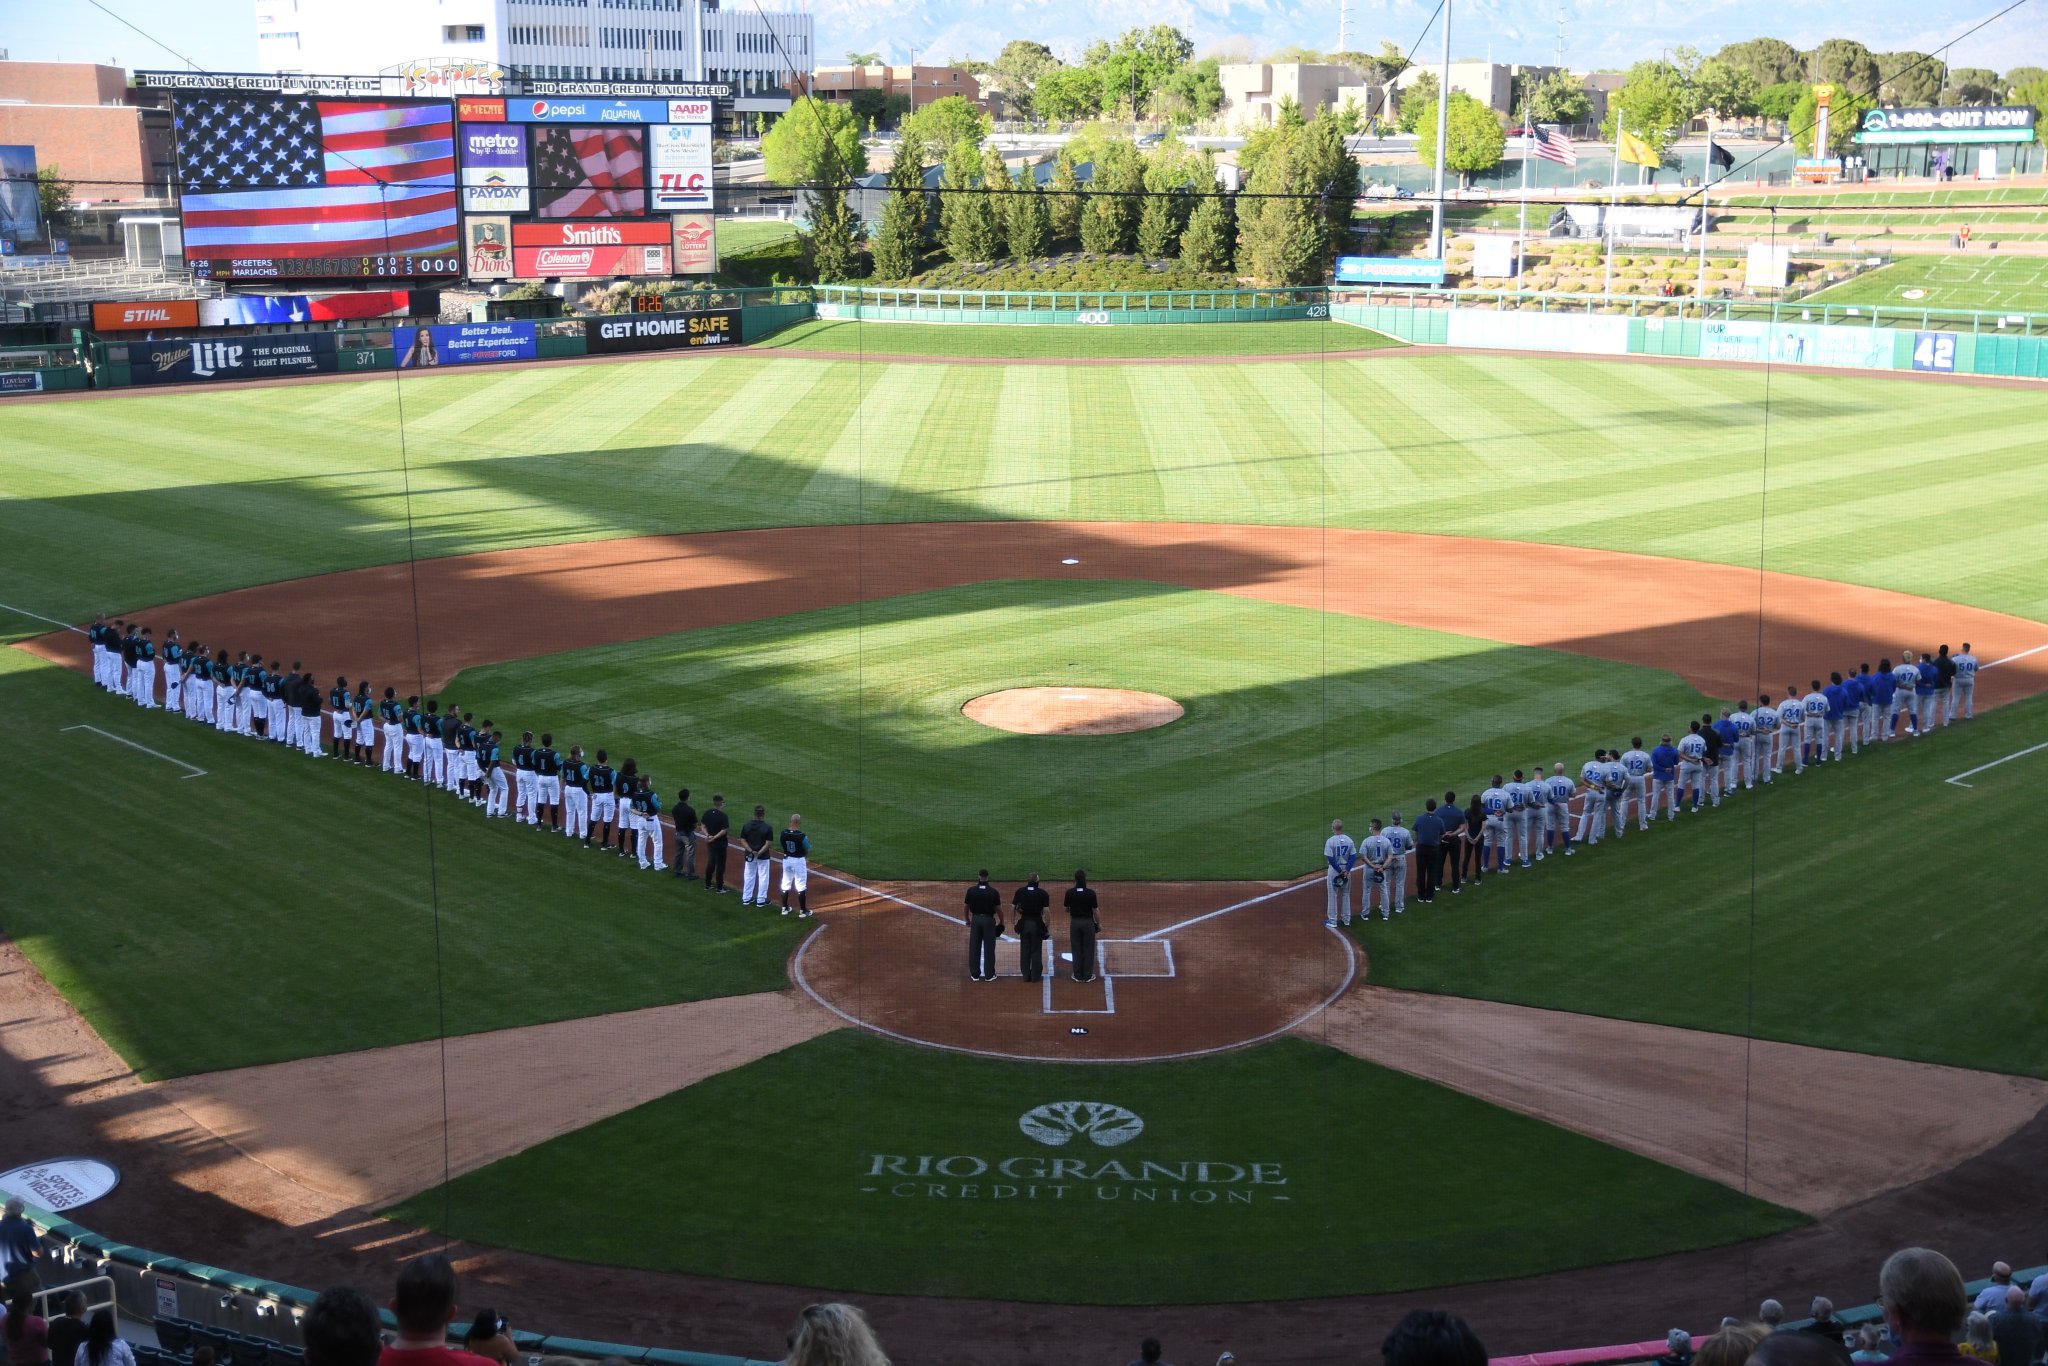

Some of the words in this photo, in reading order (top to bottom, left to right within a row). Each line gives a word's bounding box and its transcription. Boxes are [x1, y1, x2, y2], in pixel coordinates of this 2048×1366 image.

[402, 63, 504, 91] ISOTOPES
[147, 75, 171, 87] RIO
[176, 76, 233, 88] GRANDE
[238, 77, 283, 89] CREDIT
[289, 78, 329, 90] UNION
[336, 80, 371, 91] FIELD
[534, 83, 555, 94] RIO
[560, 83, 608, 95] GRANDE
[612, 84, 652, 95] CREDIT
[656, 84, 694, 95] UNION
[697, 84, 728, 96] FIELD
[551, 104, 586, 116] pepsi
[670, 104, 708, 114] AARP
[602, 109, 641, 121] AQUAFINA
[1984, 110, 2029, 127] NOW
[470, 134, 518, 148] metro
[476, 148, 484, 156] by
[659, 173, 704, 191] TLC
[470, 188, 522, 198] PAYDAY
[563, 225, 621, 245] Smith's
[363, 257, 369, 265] 0
[377, 257, 383, 265] 0
[390, 257, 396, 265] 0
[469, 247, 512, 272] Dion's
[541, 252, 580, 265] Coleman
[364, 267, 369, 275] 0
[378, 267, 384, 275] 0
[390, 267, 396, 275] 0
[421, 260, 430, 271] 0
[435, 260, 443, 271] 0
[449, 260, 457, 271] 0
[124, 309, 171, 322] STIHL
[1306, 306, 1327, 317] 428
[1076, 312, 1108, 324] 400
[461, 327, 489, 336] Better
[491, 326, 513, 334] Deal.
[601, 322, 632, 338] GET
[636, 319, 685, 336] HOME
[689, 317, 729, 333] SAFE
[1707, 324, 1726, 334] OUR
[448, 339, 476, 348] Better
[690, 334, 720, 345] endwi
[252, 348, 269, 356] THE
[272, 345, 310, 355] ORIGINAL
[1914, 337, 1954, 369] 42
[152, 349, 192, 370] Miller
[190, 343, 243, 376] Lite
[253, 358, 277, 367] LIGHT
[280, 356, 314, 366] PILSNER.
[356, 351, 375, 365] 371
[1810, 702, 1823, 711] 36
[1785, 709, 1799, 717] 34
[1735, 721, 1749, 730] 30
[1759, 717, 1773, 725] 32
[1690, 744, 1701, 753] 15
[1630, 760, 1643, 769] 12
[1586, 770, 1600, 781] 22
[1553, 786, 1566, 796] 10
[1489, 798, 1501, 809] 16
[1336, 845, 1348, 856] 17
[864, 1154, 988, 1177] RIO
[999, 1156, 1288, 1184] GRANDE
[44, 1174, 83, 1198] SPORTS
[27, 1181, 71, 1208] WELLNESS
[892, 1183, 1071, 1199] CREDIT
[1097, 1186, 1254, 1204] UNION
